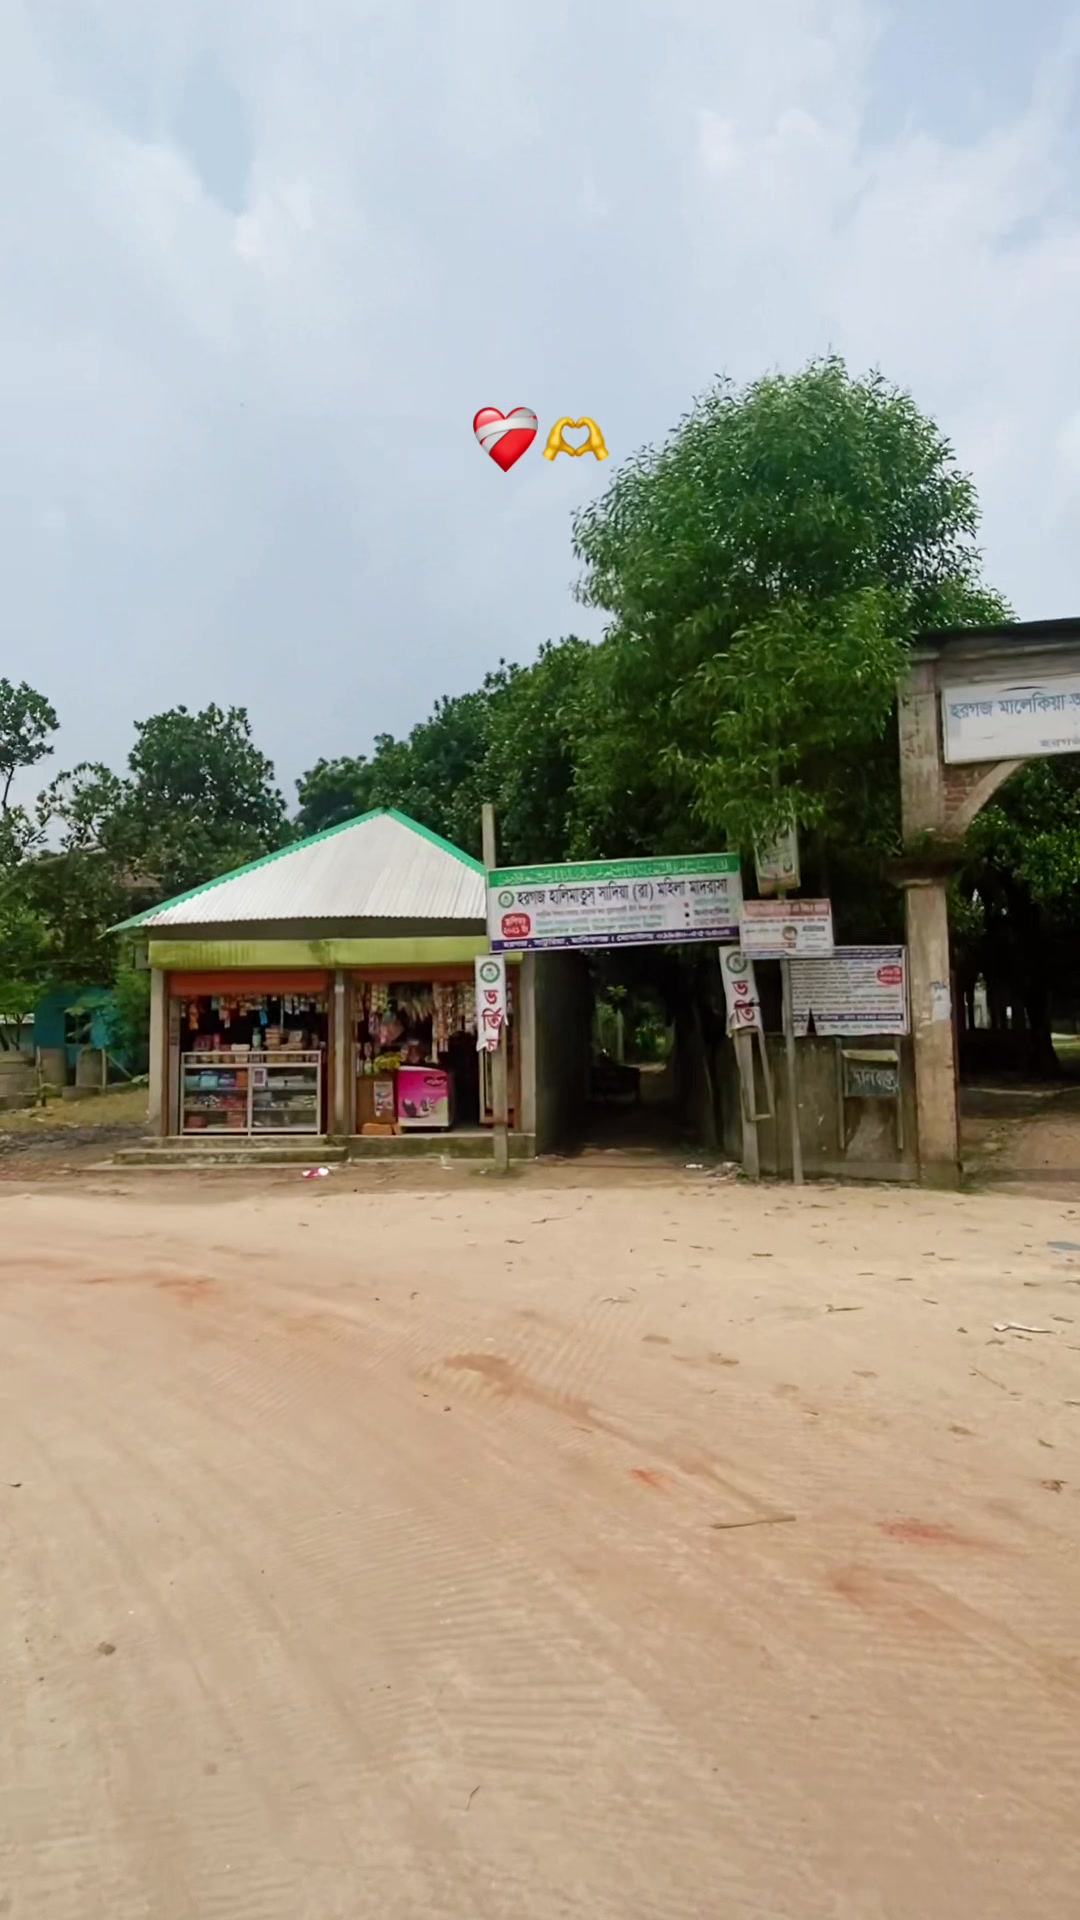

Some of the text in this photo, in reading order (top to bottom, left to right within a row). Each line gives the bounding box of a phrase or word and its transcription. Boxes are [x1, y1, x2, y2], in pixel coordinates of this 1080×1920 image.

[949, 701, 993, 719] হরগজ
[998, 692, 1067, 715] মালেকিয়া
[517, 891, 546, 907] হরগজ
[597, 880, 629, 901] সাদিয়া
[656, 876, 685, 897] মহিলা
[688, 879, 727, 895] মাদরাসা
